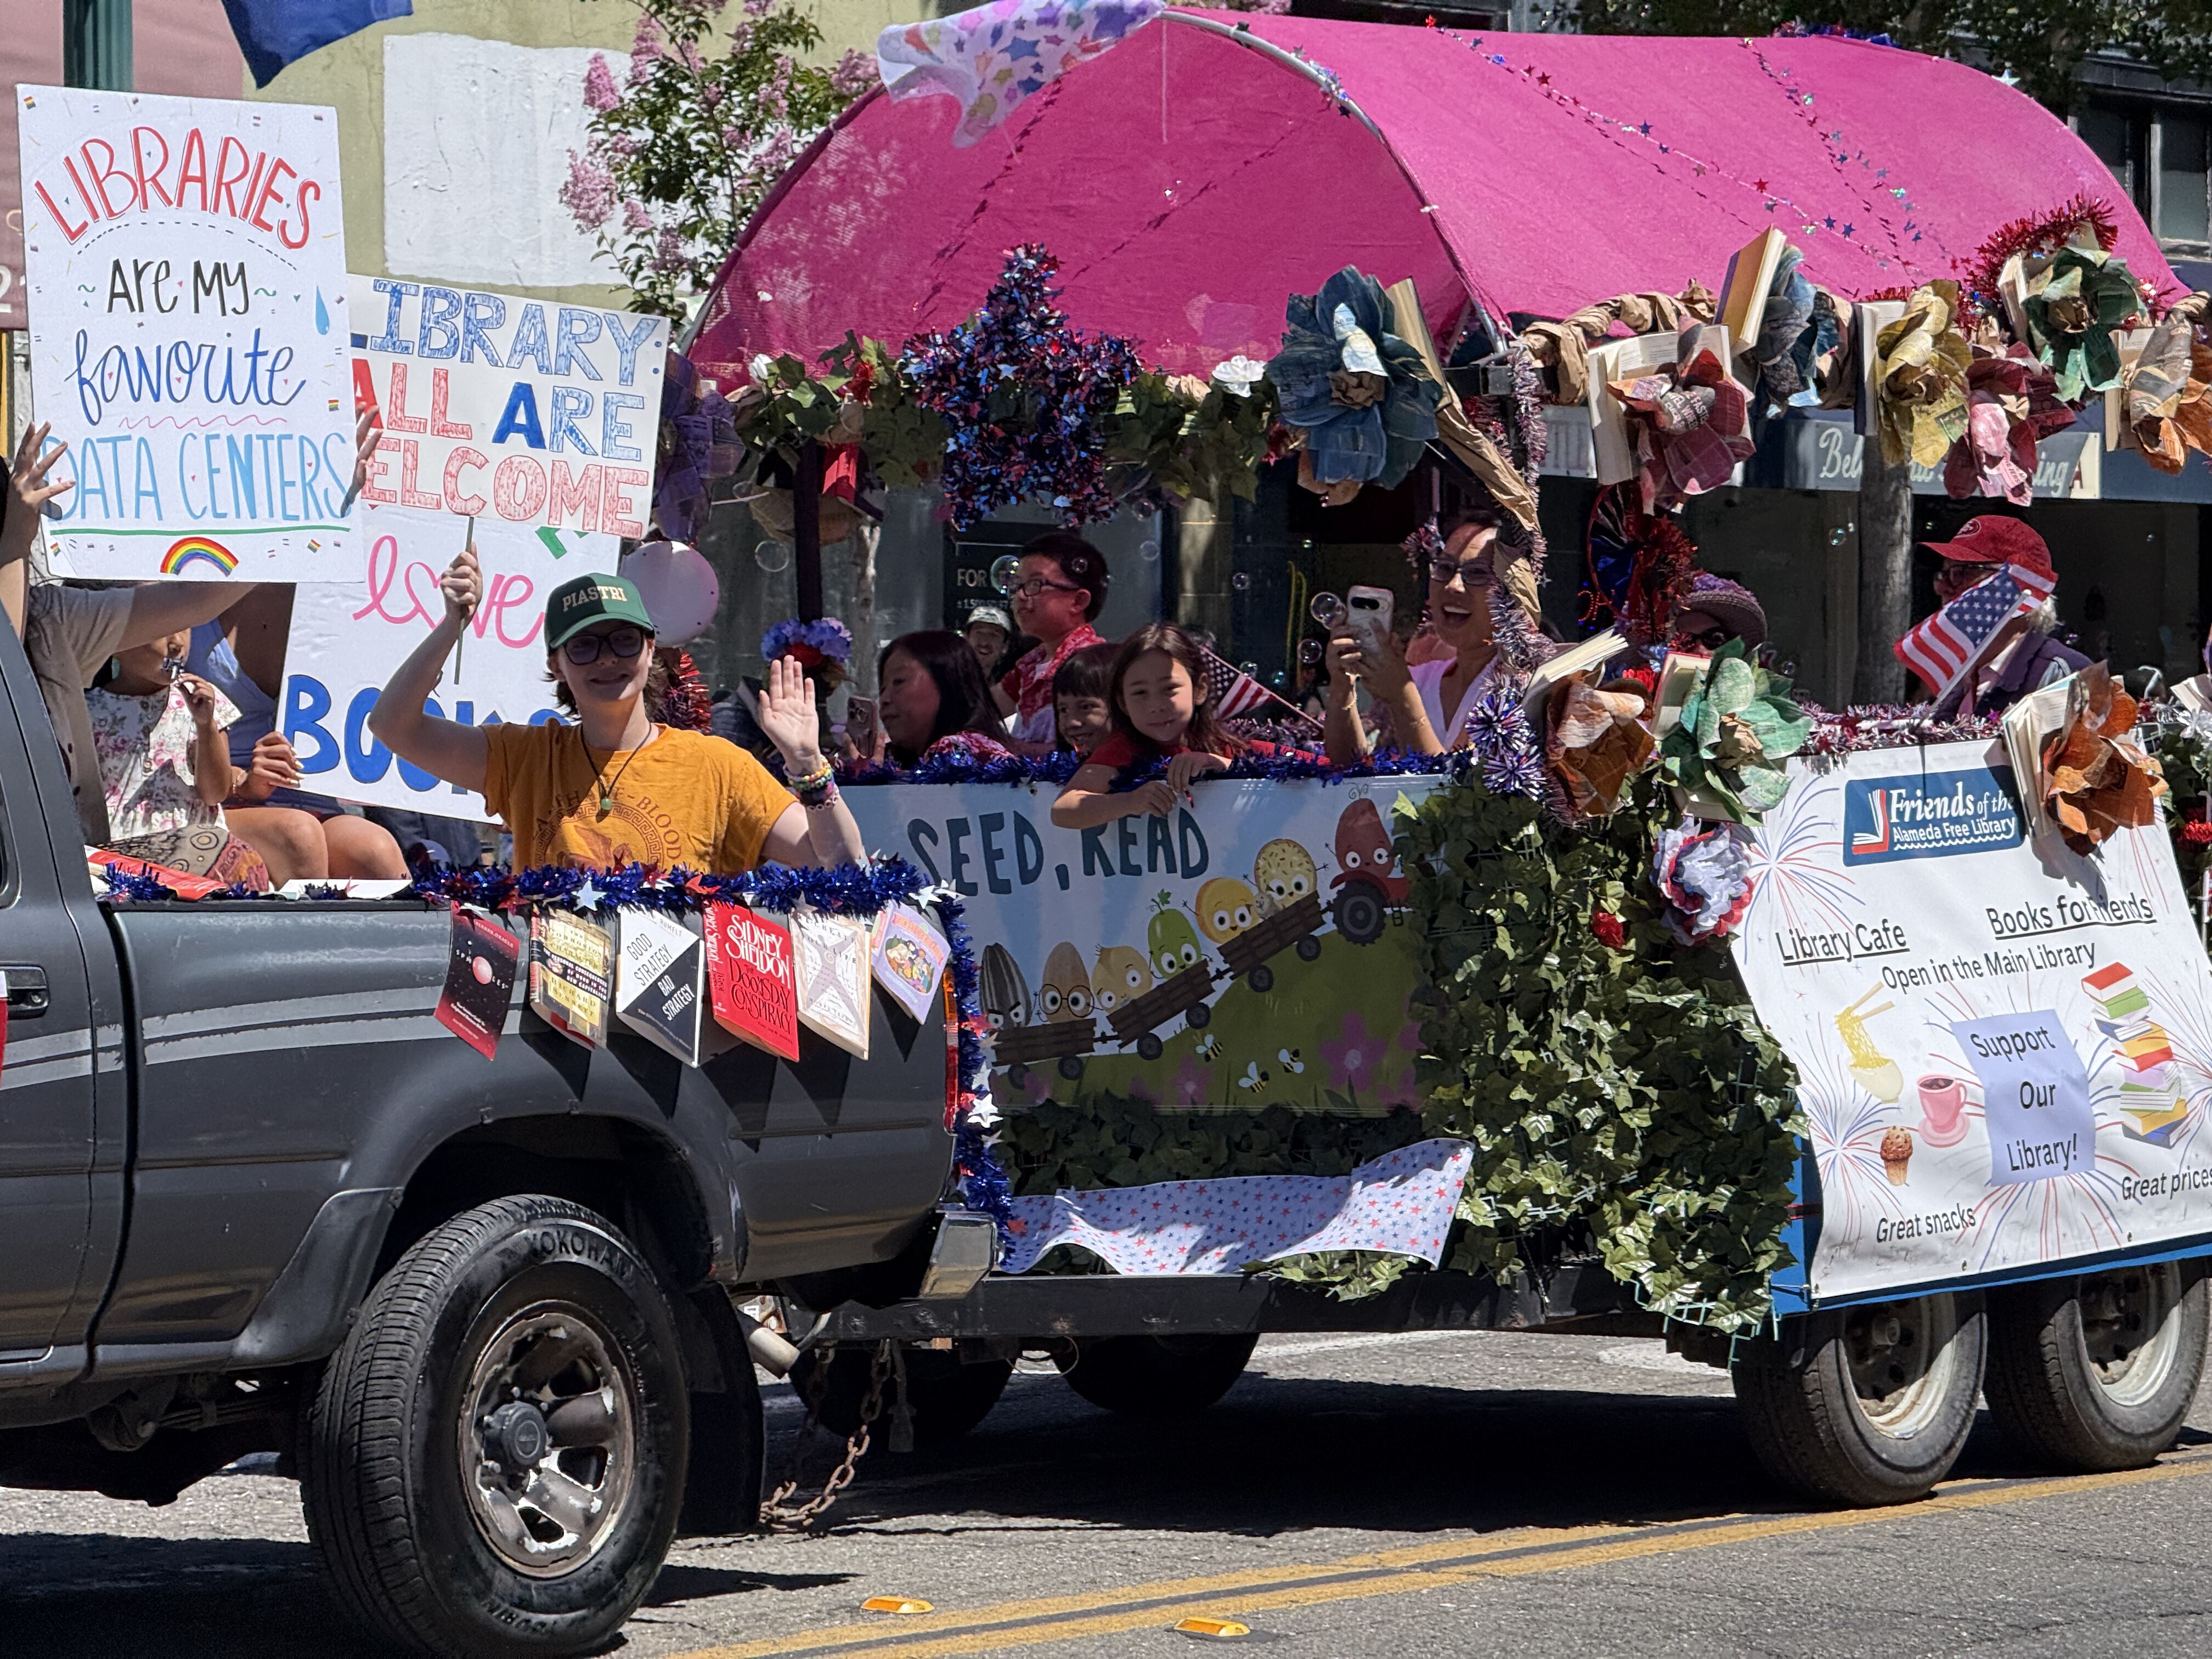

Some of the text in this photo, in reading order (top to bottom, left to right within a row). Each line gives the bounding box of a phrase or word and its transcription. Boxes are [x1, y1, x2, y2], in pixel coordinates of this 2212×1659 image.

[34, 126, 321, 250] LIBRARIES
[351, 279, 662, 386] IBRARY:
[65, 328, 307, 425] favorite
[492, 382, 645, 462] ARE
[41, 433, 352, 522] DATA CENTERS
[359, 437, 649, 540] ELCOME
[562, 585, 628, 612] PIASTRI
[957, 568, 988, 587] FOR
[1889, 781, 2013, 823] Friends of the
[1893, 816, 2017, 843] Alameda Free Library
[907, 806, 1209, 897] SEED, READ
[659, 918, 683, 938] RUMELT
[1985, 901, 2053, 935] Books
[2056, 895, 2091, 926] for
[627, 933, 653, 961] GOOD
[725, 925, 791, 989] SHELDON
[727, 914, 783, 959] SIDNEY
[1776, 919, 1907, 963] Library Cafe
[634, 944, 673, 986] STRATEGY
[657, 974, 675, 997] BAD
[729, 957, 791, 1013] DOOMSDAY
[1882, 942, 2096, 995] Open in the Main Library
[662, 983, 696, 1022] STRATEGY
[731, 984, 792, 1035] CONSPIRACY
[1970, 1026, 2056, 1062] Support
[2019, 1081, 2056, 1110] Our
[2006, 1133, 2078, 1171] Library!
[2121, 1174, 2168, 1200] Great
[1876, 1203, 1976, 1243] Great snacks
